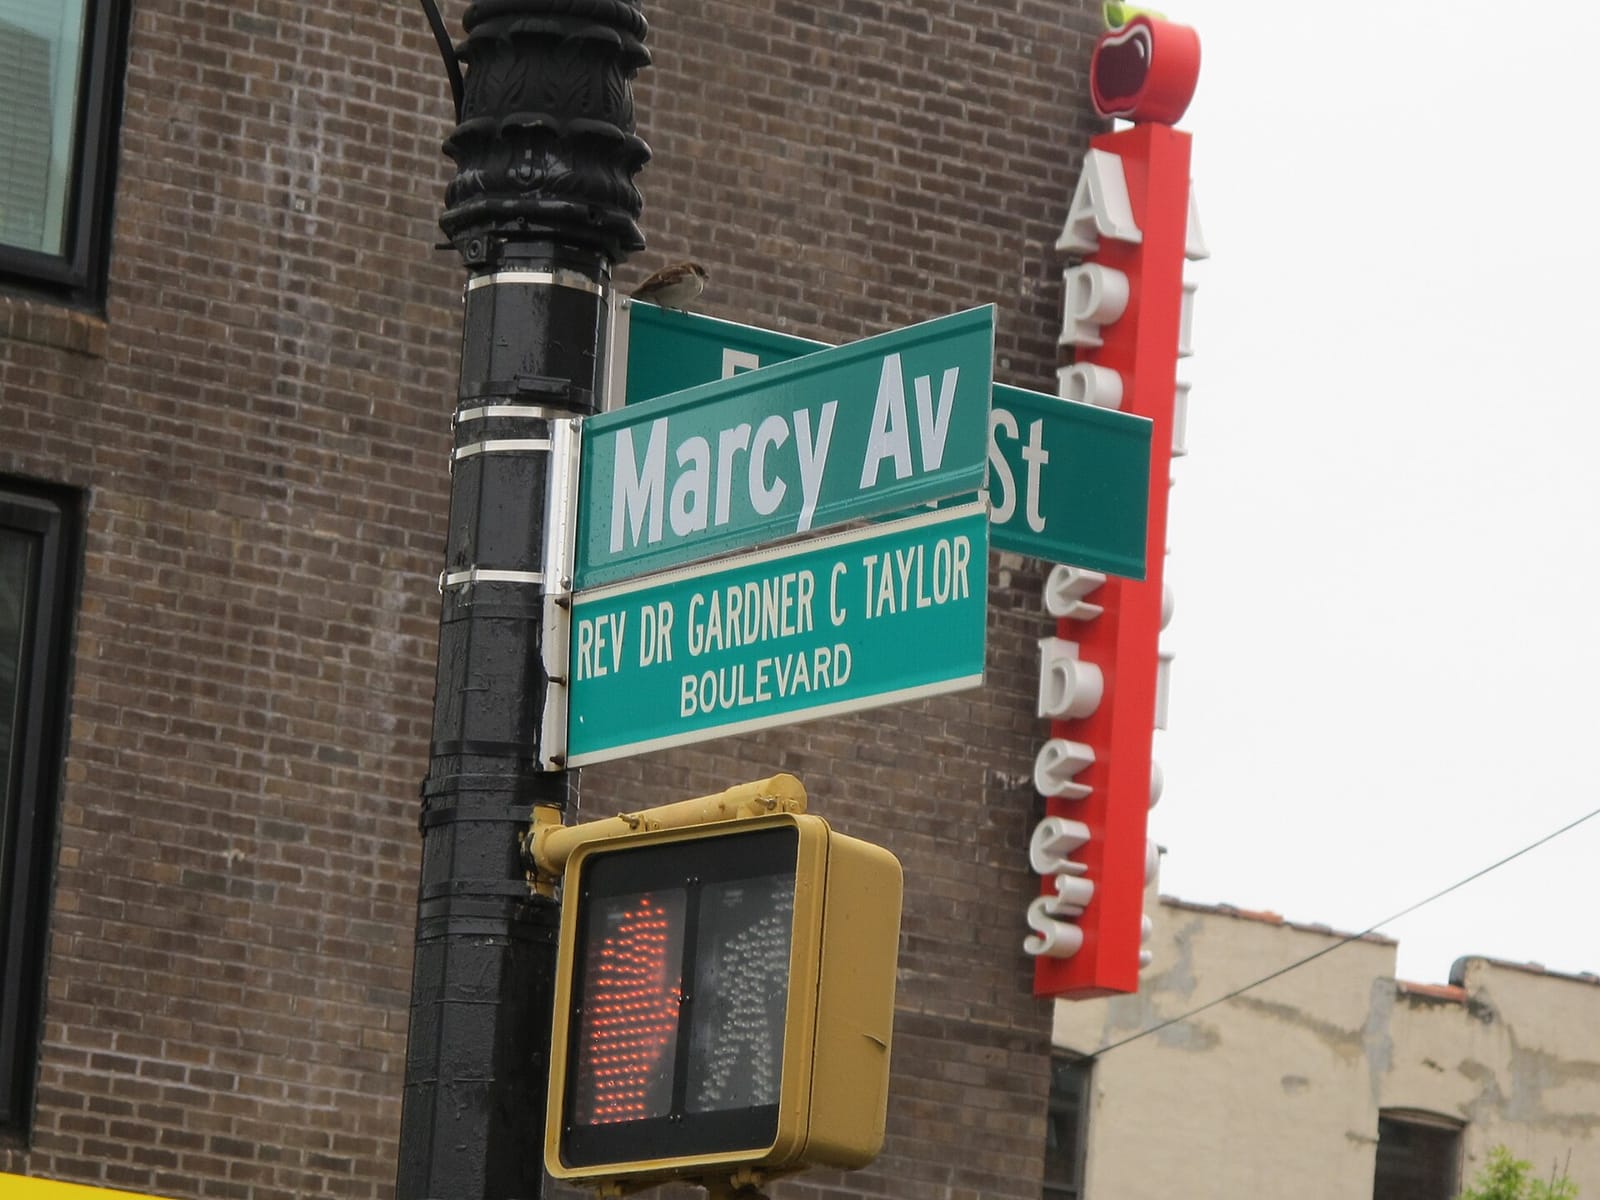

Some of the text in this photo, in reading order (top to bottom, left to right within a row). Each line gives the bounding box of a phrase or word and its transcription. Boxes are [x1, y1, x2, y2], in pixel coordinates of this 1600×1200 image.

[609, 352, 960, 554] Marcy Av
[978, 408, 1049, 533] St
[577, 536, 970, 681] REV DR GARDNER C TAYLOR
[1022, 148, 1142, 959] Appebee's
[680, 643, 852, 718] BOULEVARD
